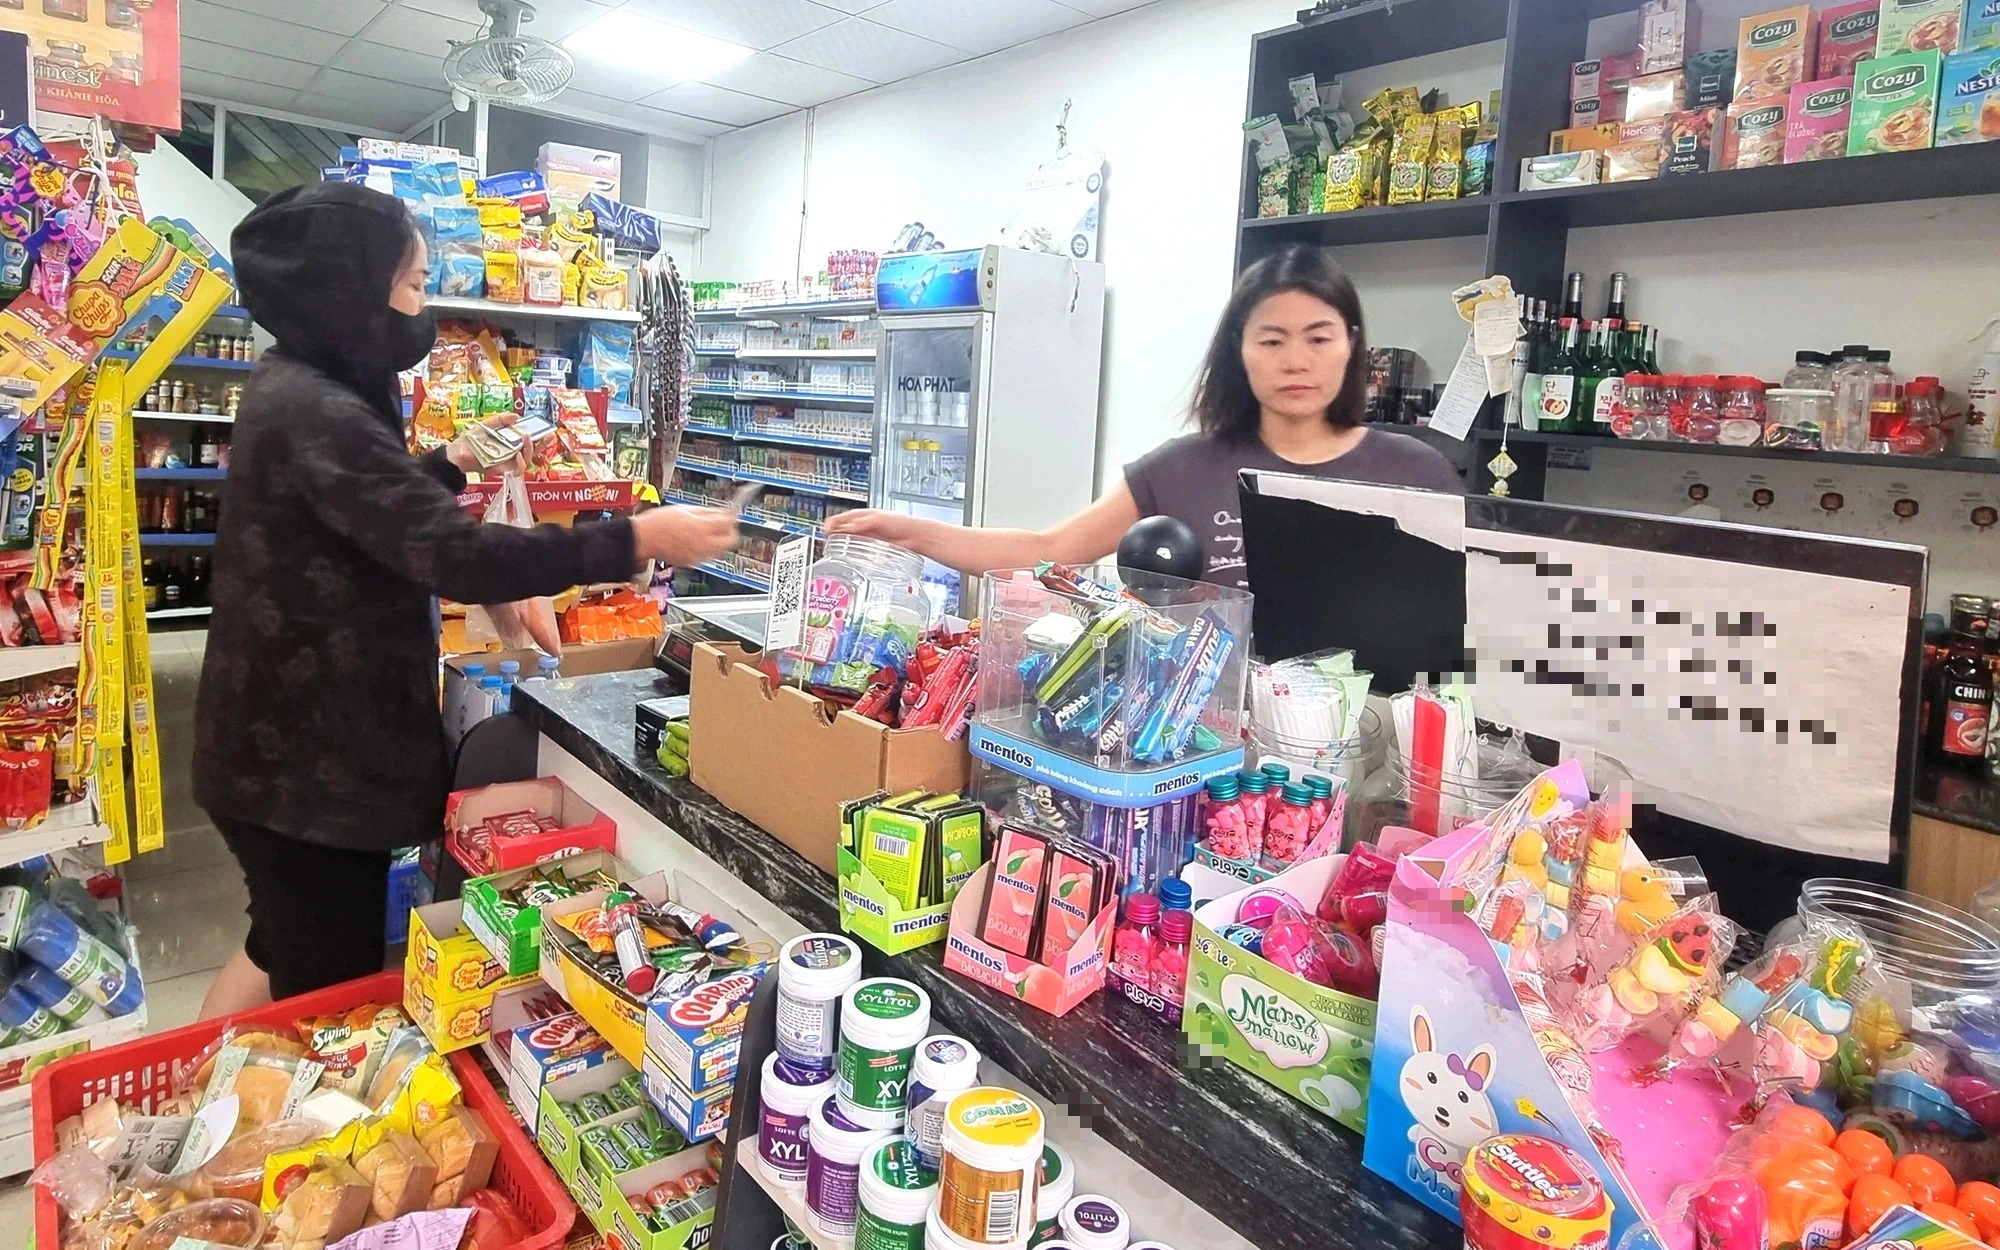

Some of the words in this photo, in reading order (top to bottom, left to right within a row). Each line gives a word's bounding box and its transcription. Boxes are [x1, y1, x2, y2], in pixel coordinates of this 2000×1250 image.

[1754, 23, 1792, 40] Cozy
[1835, 14, 1876, 33] Cozy
[1872, 71, 1917, 90] Cozy
[1809, 92, 1845, 107] Cozy
[1742, 108, 1778, 126] Cozy
[101, 259, 121, 285] SOUR
[73, 291, 101, 320] Chupa
[82, 299, 112, 328] Chups
[980, 738, 1033, 768] mentos
[1154, 772, 1199, 795] mentos
[997, 874, 1035, 893] mentos
[844, 889, 884, 916] mentos
[1051, 897, 1086, 920] mentos
[894, 912, 950, 934] mentos
[950, 937, 1003, 972] mentos
[1070, 951, 1104, 976] mentos
[858, 992, 915, 1008] XYLITOL
[313, 1025, 351, 1052] Swing
[775, 1127, 797, 1137] LOTTE
[1489, 1144, 1560, 1200] Skittles
[1078, 1211, 1116, 1223] XYLITOL
